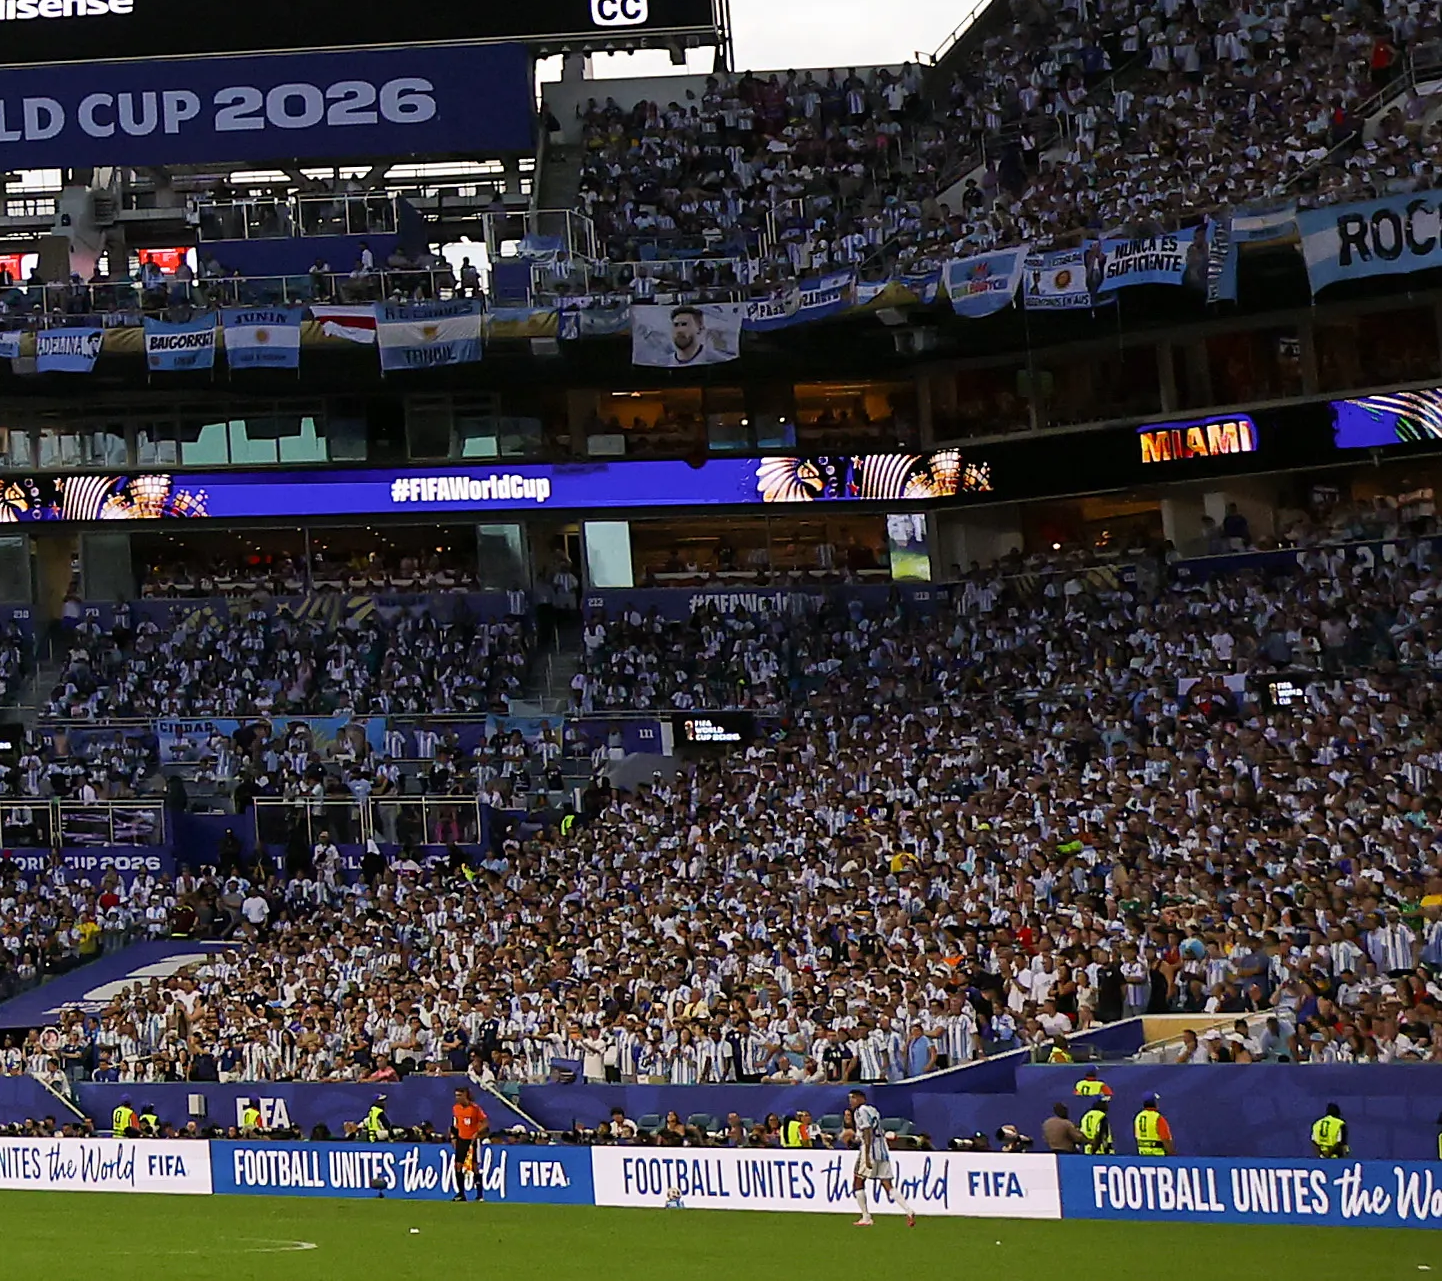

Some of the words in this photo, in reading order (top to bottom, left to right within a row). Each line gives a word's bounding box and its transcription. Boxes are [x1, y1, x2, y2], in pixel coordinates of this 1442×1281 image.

[78, 89, 201, 138] CUP
[214, 77, 437, 130] 2026
[1115, 238, 1160, 262] NUNCA
[1160, 236, 1179, 252] ES
[1336, 197, 1442, 267] ROC
[235, 311, 287, 325] JUNIN
[37, 335, 83, 359] ADELINA
[1141, 421, 1252, 464] MIAMI
[390, 473, 551, 503] #FIFAWorldCup
[100, 856, 160, 870] 2026
[236, 1097, 291, 1129] FFA
[45, 1142, 77, 1181] the
[79, 1143, 136, 1187] World
[147, 1154, 187, 1178] FIFA
[234, 1148, 325, 1189] FOOTBALL
[329, 1151, 396, 1190] UNITES
[399, 1147, 441, 1193] the
[519, 1160, 567, 1188] FIFA
[622, 1157, 730, 1198] FOOTBALL
[737, 1159, 815, 1201] UNITES
[968, 1171, 1024, 1199] FIFA
[1092, 1164, 1226, 1213] FOOTBALL
[1231, 1167, 1330, 1215] UNITES
[1333, 1161, 1392, 1219] the
